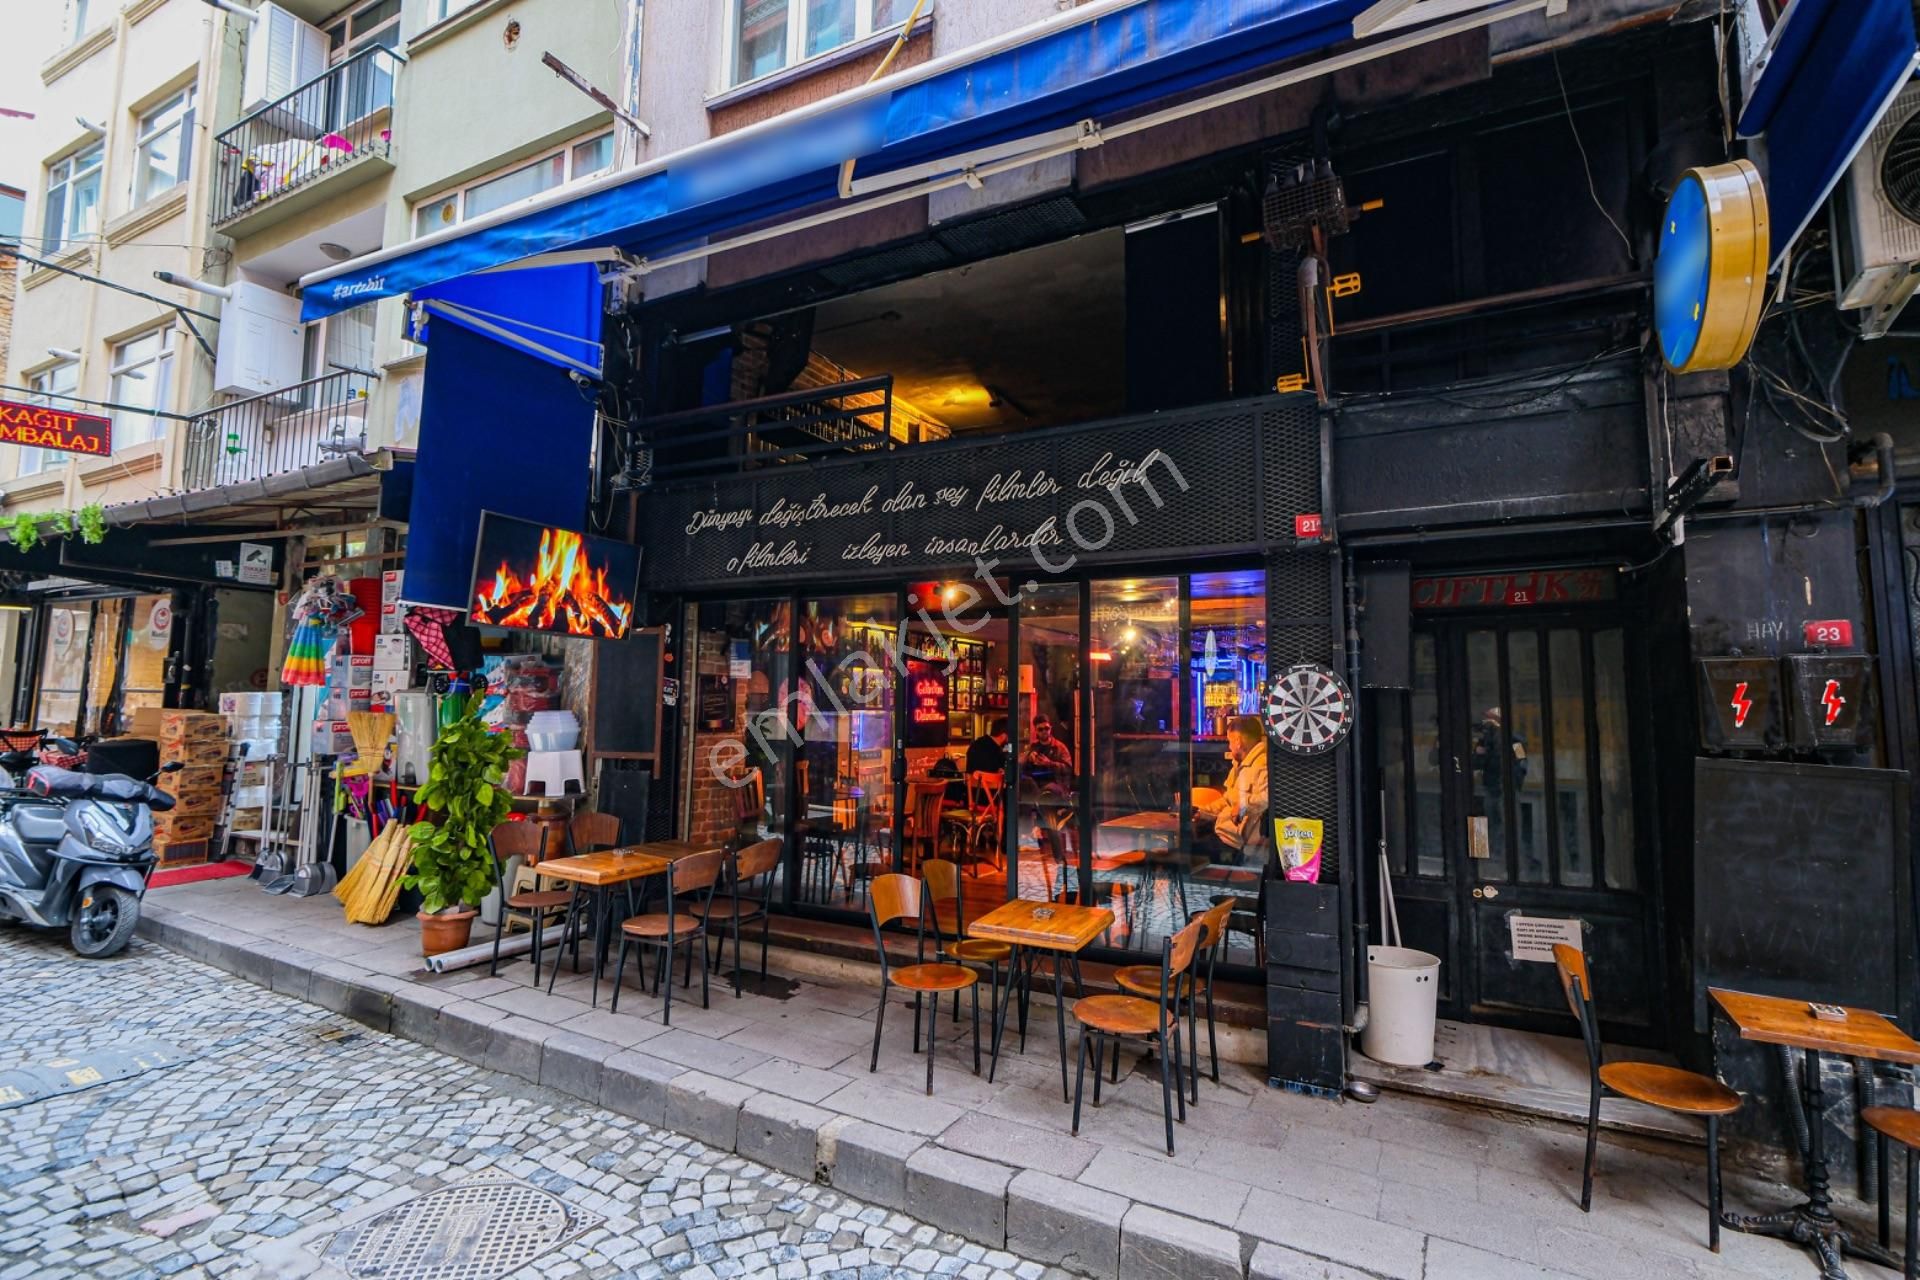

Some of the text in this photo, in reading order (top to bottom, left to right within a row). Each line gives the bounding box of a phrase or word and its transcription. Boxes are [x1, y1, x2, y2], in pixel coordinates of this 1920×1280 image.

[0, 407, 78, 432] KAĞIT
[0, 424, 99, 452] MBALAJ
[685, 507, 753, 535] Dünyayı
[758, 485, 873, 528] değiştirecek
[881, 481, 926, 513] olan
[932, 485, 970, 507] şey
[975, 470, 1063, 511] filmler
[726, 516, 1064, 574] o filmleri izleyen insanlardır
[1514, 592, 1528, 602] 21
[1817, 627, 1840, 641] 23
[333, 723, 349, 732] pro
